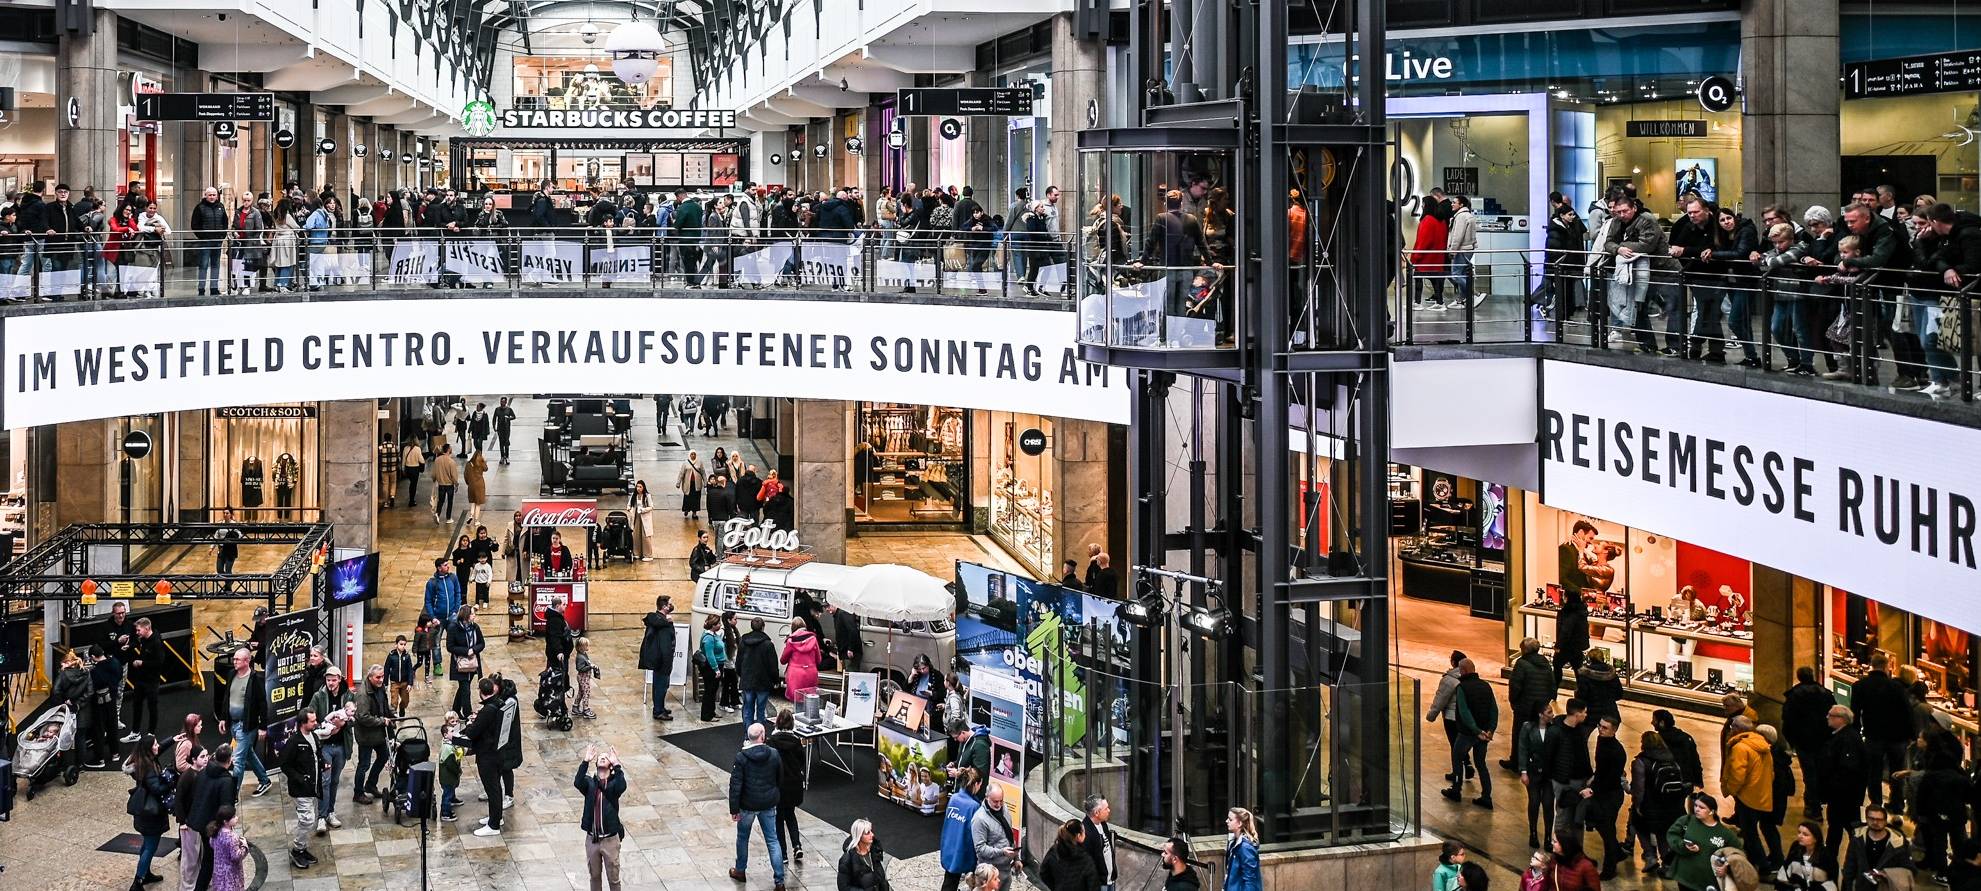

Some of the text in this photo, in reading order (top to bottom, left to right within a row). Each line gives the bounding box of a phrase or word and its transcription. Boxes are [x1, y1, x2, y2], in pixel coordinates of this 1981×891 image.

[1386, 51, 1452, 80] Live
[1850, 68, 1859, 93] 1
[142, 98, 152, 117] 1
[904, 93, 914, 112] 1
[504, 110, 735, 128] STARBUCKS COFFEE
[1639, 122, 1695, 136] WILLKOMMEN
[18, 329, 1109, 392] IM WESTFIELD CENTRO. VERKAUFSOFFENER SONNTAG AM
[223, 407, 309, 418] SCOTCH&SODA
[1544, 409, 1980, 570] REISEMESSE RUHR
[723, 517, 800, 551] Fotos
[946, 806, 967, 823] Team
